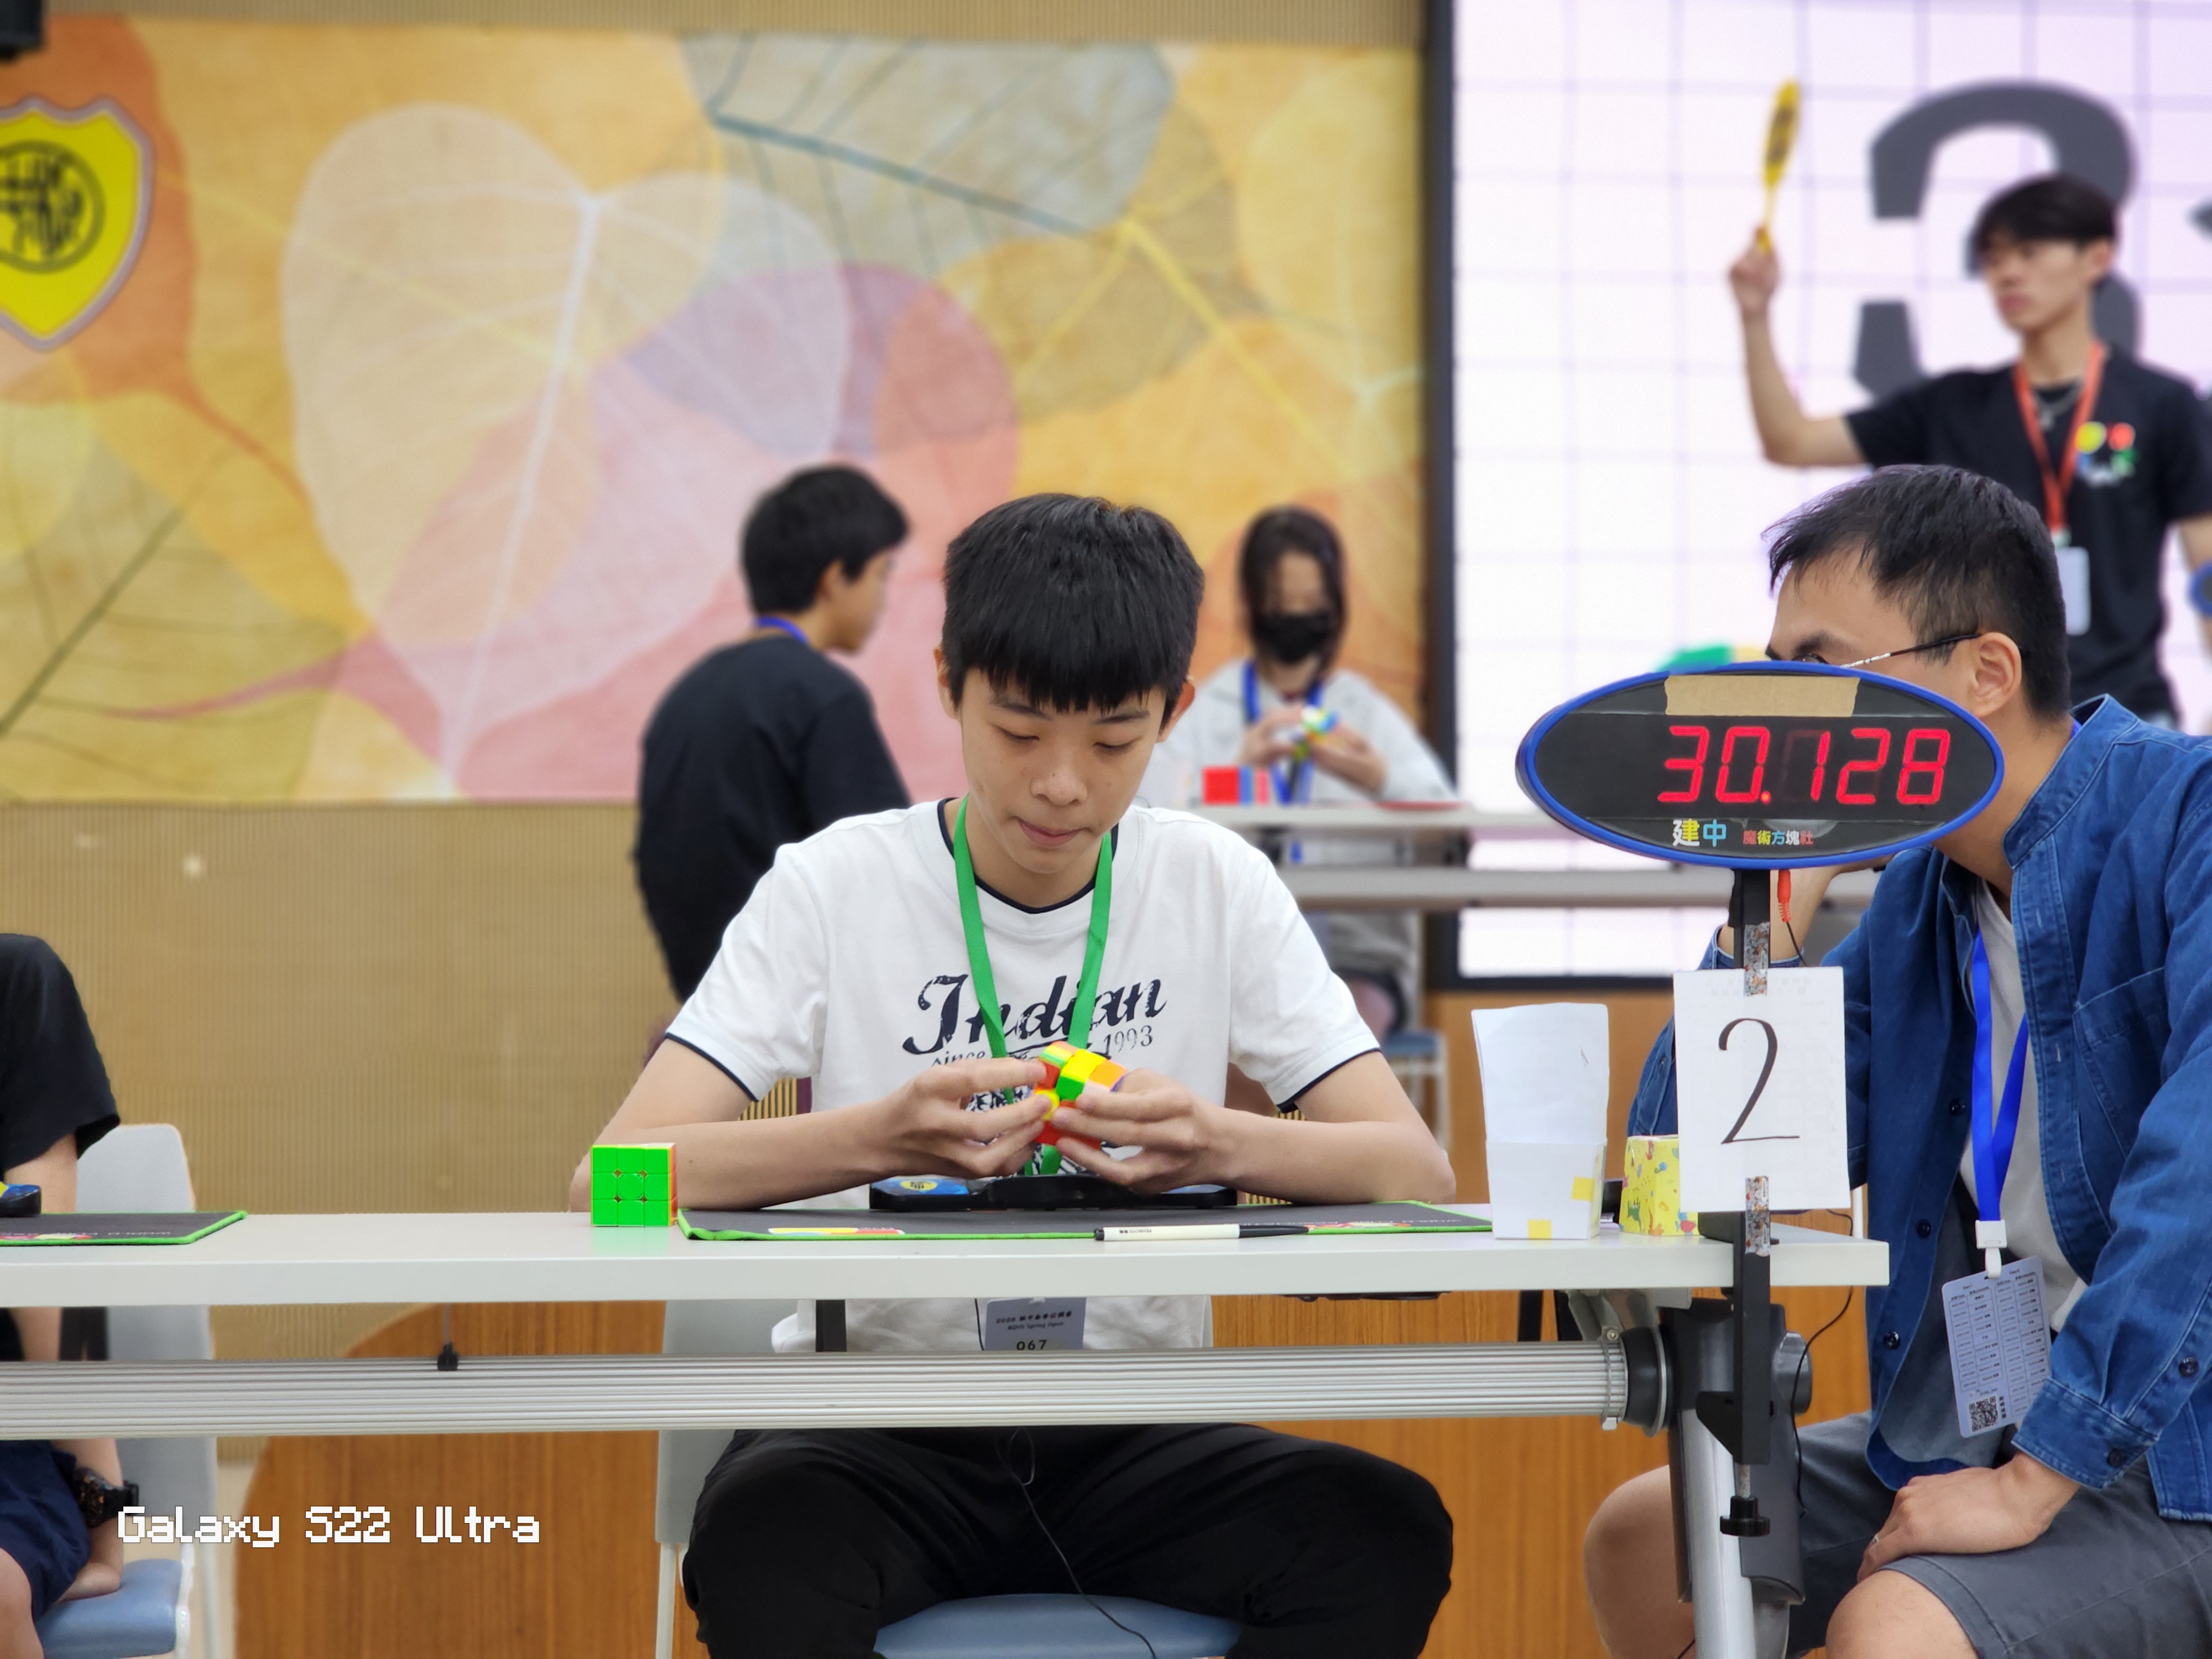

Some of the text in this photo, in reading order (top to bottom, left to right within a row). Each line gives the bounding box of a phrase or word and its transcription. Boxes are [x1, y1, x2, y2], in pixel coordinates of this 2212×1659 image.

[1658, 725, 1950, 805] 30.128
[1672, 818, 1814, 847] 建中 魔術方塊社
[1103, 1025, 1153, 1056] 1993
[1718, 1018, 1801, 1145] 2
[1016, 1339, 1047, 1350] 067
